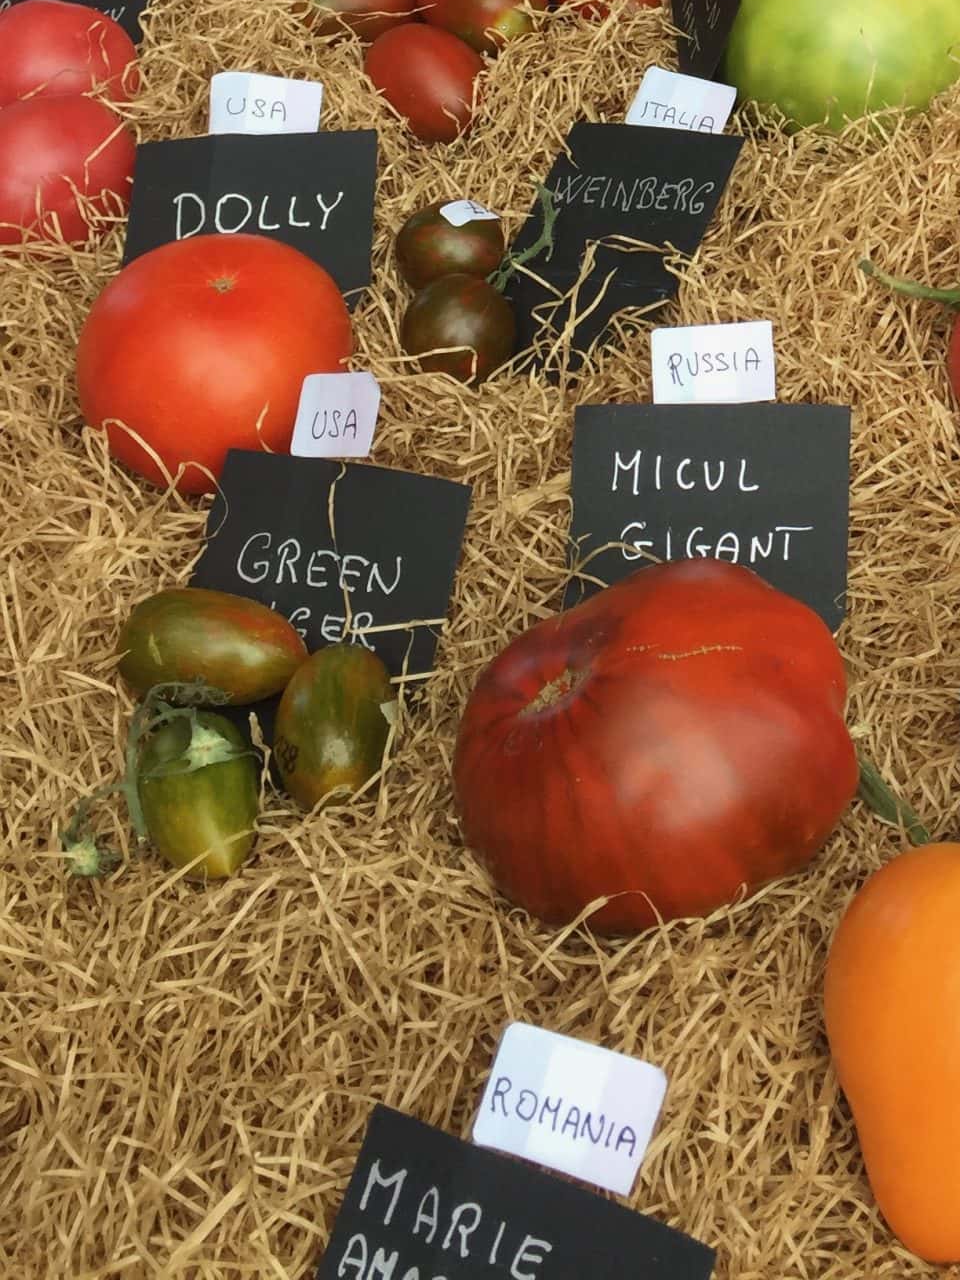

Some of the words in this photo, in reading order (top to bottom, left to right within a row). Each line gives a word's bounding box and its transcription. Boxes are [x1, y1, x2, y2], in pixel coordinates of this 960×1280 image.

[226, 97, 286, 122] USA
[641, 100, 715, 134] ITALIA
[553, 173, 715, 215] WEINBERG
[173, 191, 344, 240] DOLLY
[667, 347, 761, 386] RUSSIA
[312, 408, 358, 439] USA
[612, 449, 760, 495] MICUL
[620, 521, 813, 563] GIGANT
[236, 532, 402, 595] GREEN
[490, 1076, 637, 1158] ROMANIA
[359, 1158, 552, 1280] MARIE
